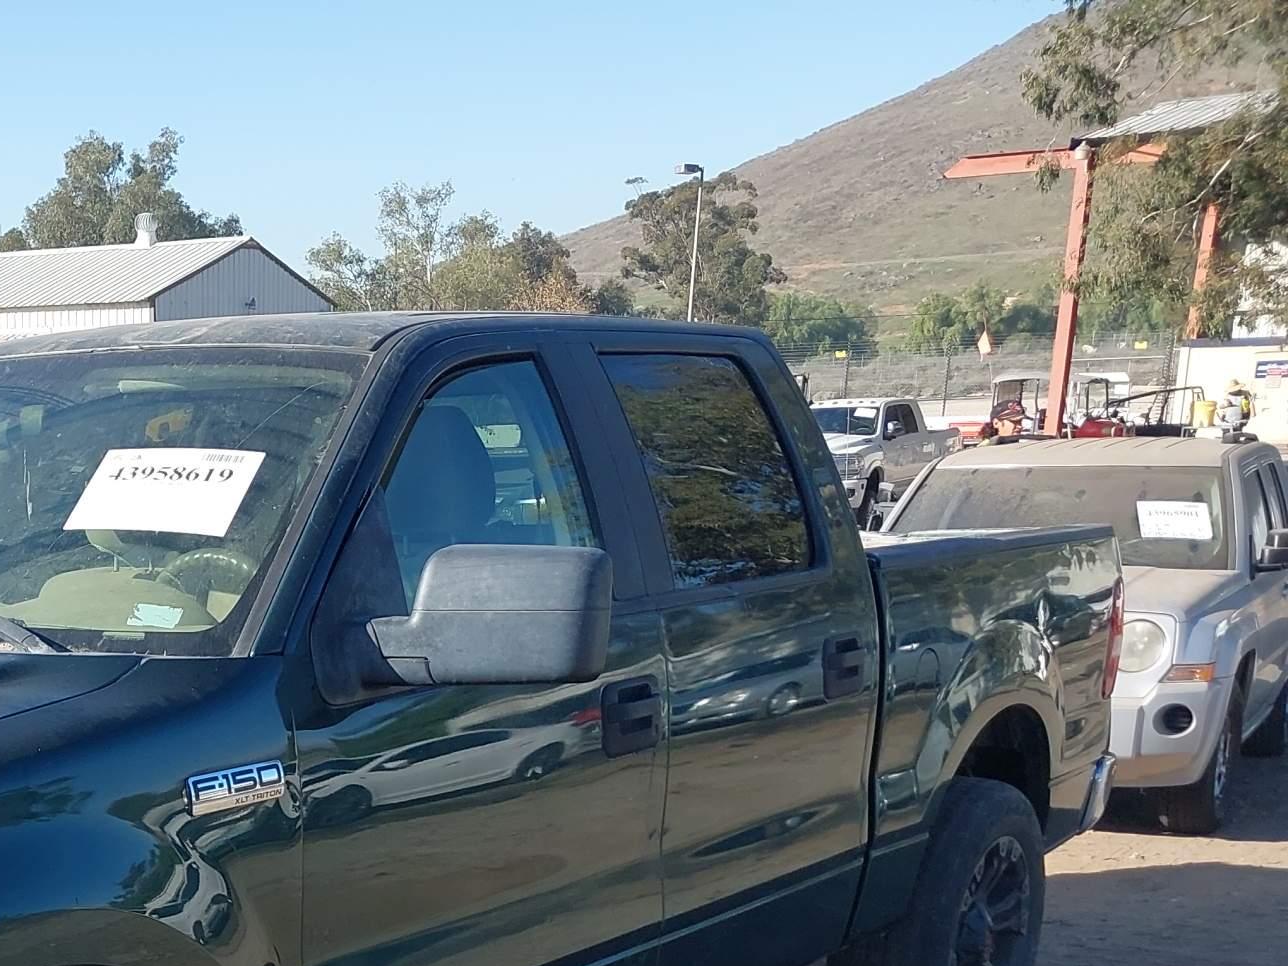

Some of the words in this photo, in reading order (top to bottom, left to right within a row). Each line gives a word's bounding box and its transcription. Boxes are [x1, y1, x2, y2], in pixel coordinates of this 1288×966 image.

[109, 466, 234, 482] 43958619
[235, 796, 250, 804] XLT
[252, 789, 282, 800] TRITON
